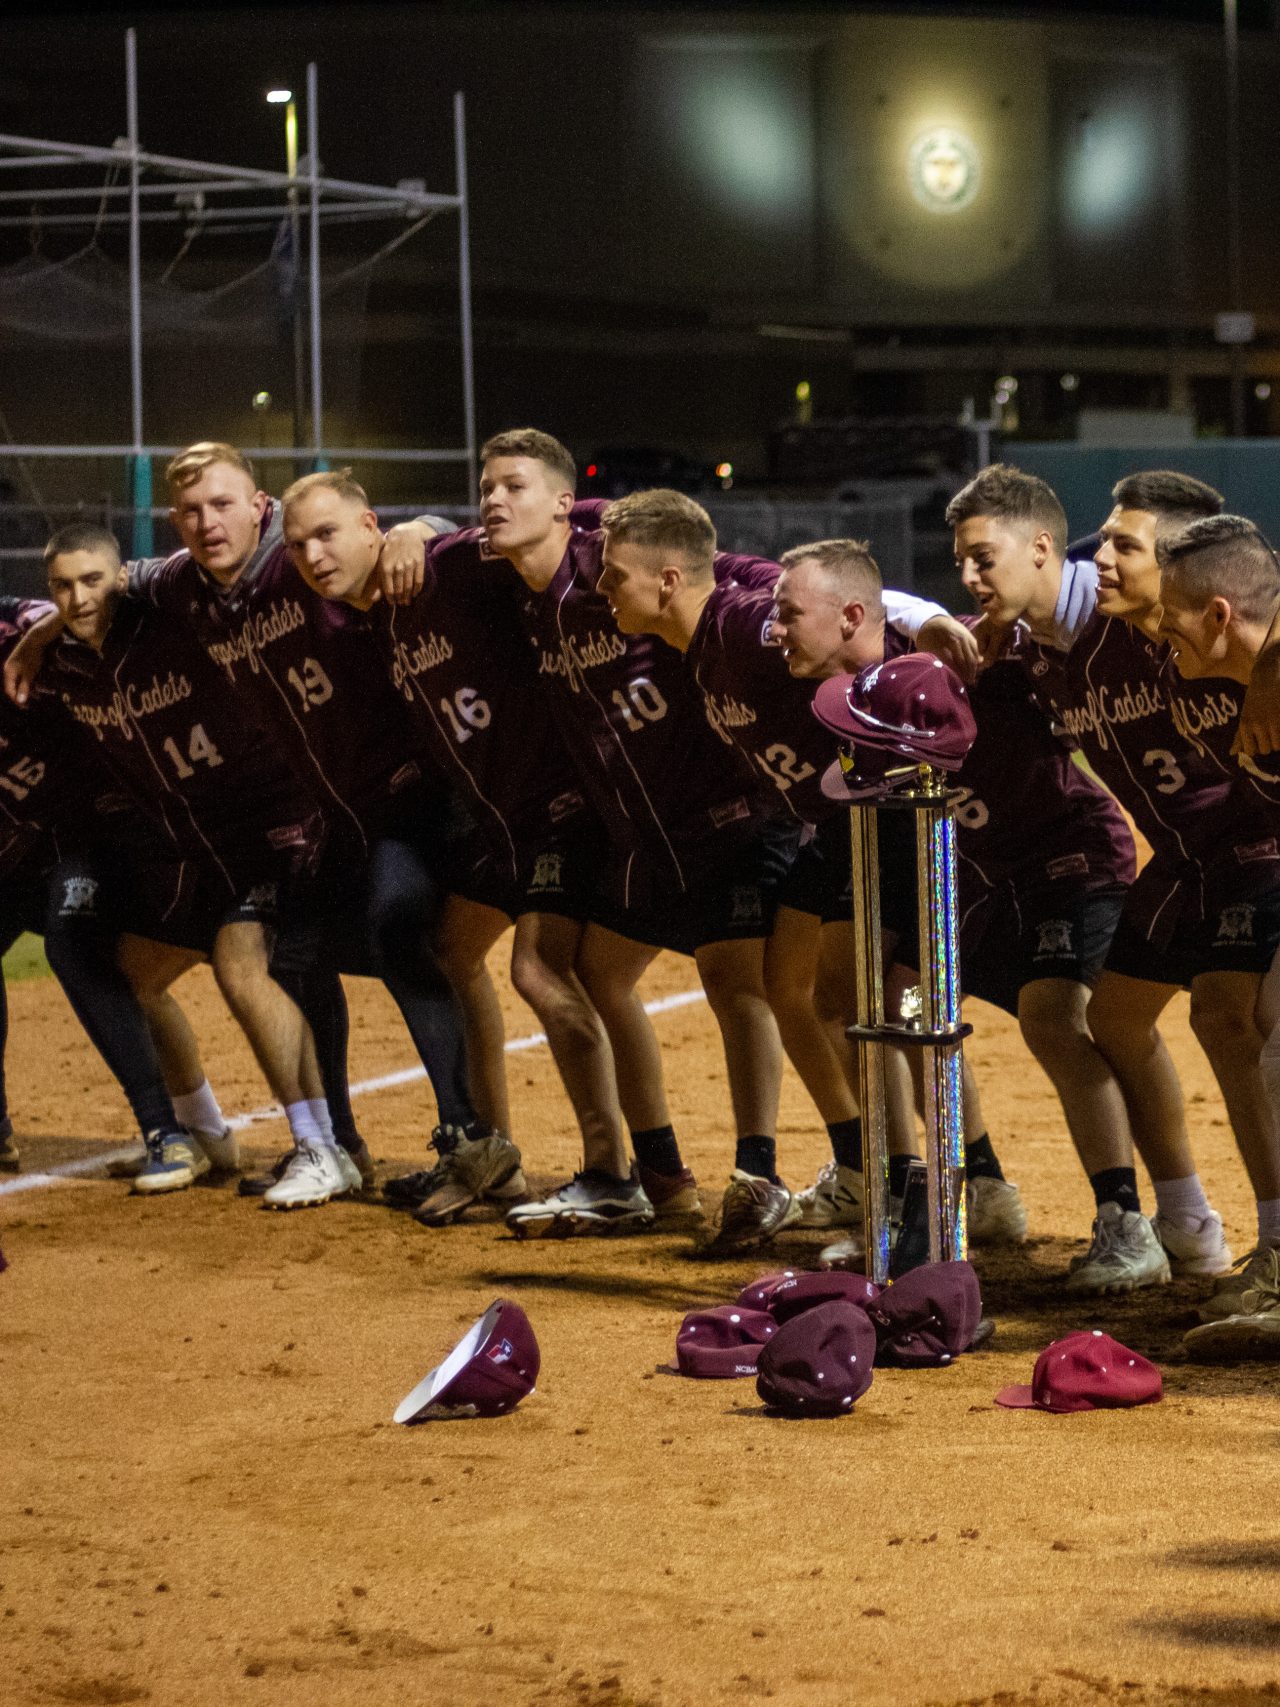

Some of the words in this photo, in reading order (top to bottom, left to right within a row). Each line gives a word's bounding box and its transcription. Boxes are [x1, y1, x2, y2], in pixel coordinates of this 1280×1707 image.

[255, 597, 306, 650] Cadets
[126, 670, 193, 719] Cadets
[440, 687, 492, 744] 16
[611, 676, 669, 732] 10
[1099, 681, 1167, 725] Cadets
[162, 722, 224, 781] 14
[754, 742, 818, 792] 12
[1142, 748, 1187, 796] 3
